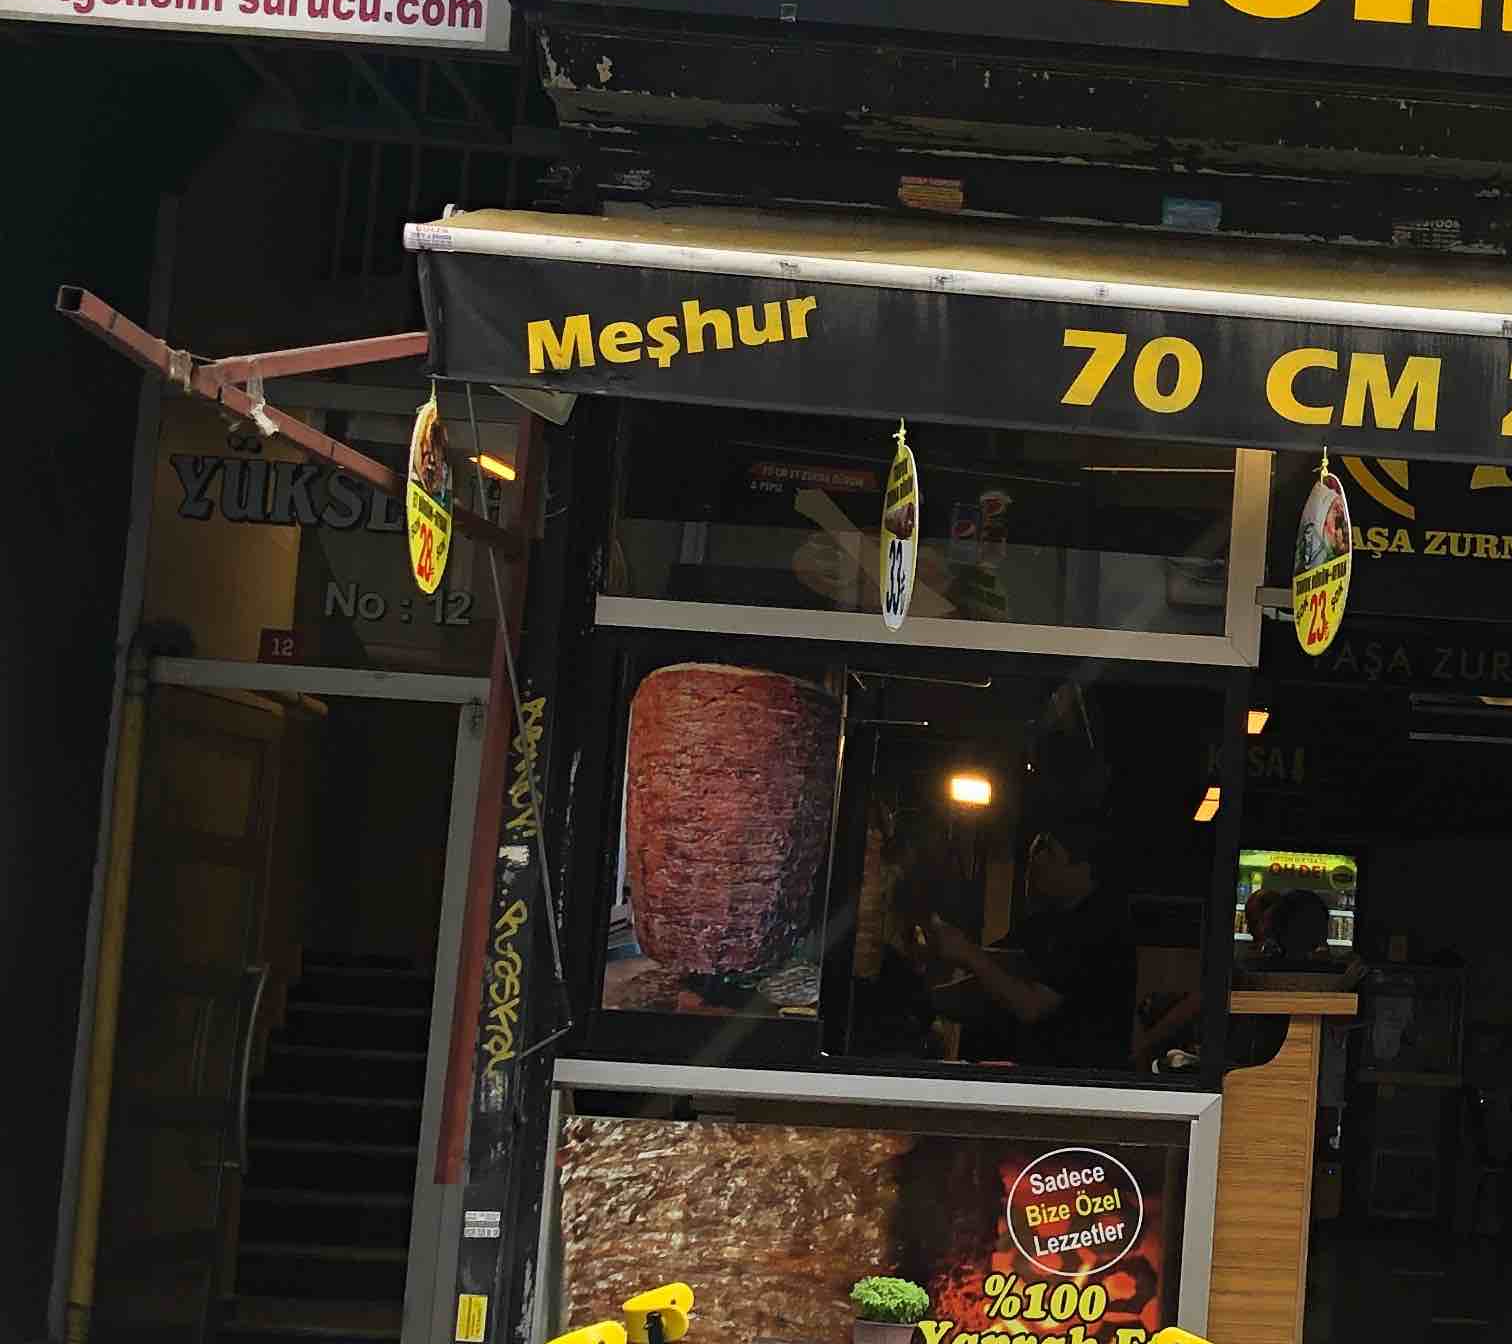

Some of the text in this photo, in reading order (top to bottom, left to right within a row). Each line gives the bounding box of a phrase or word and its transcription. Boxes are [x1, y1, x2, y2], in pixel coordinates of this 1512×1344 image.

[527, 293, 817, 375] Meşhur
[1061, 329, 1202, 414] 70
[1264, 347, 1441, 432] CM
[324, 582, 385, 620] No
[431, 591, 472, 625] 12
[271, 639, 295, 656] 12
[1029, 1163, 1105, 1196] Sadece
[1025, 1188, 1121, 1229] Bize Özel
[1033, 1220, 1125, 1257] Lezzetler
[984, 1273, 1107, 1324] %100
